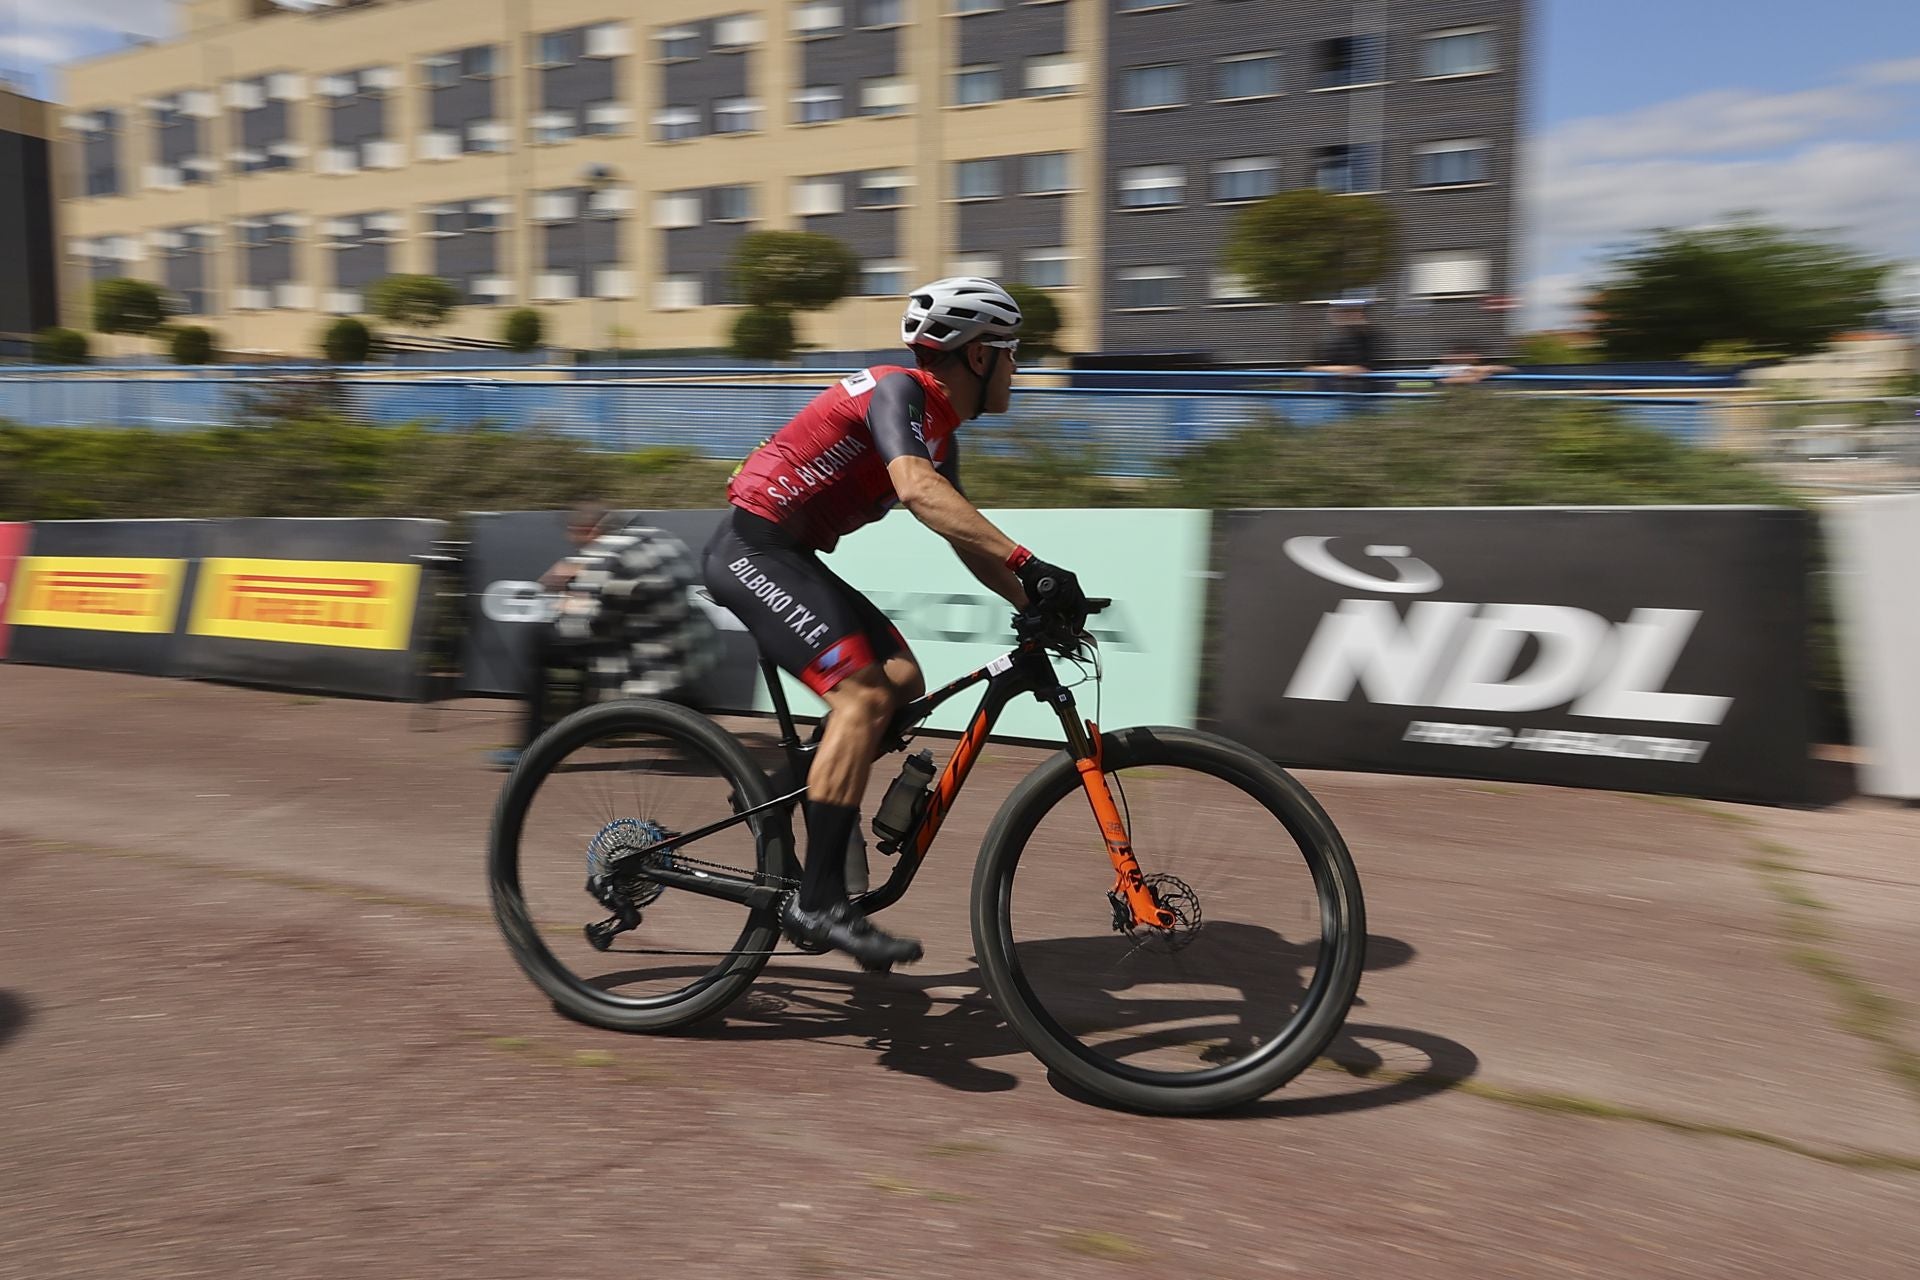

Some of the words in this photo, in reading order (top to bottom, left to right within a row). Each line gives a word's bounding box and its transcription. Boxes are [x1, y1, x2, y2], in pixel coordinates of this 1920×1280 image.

[767, 475, 804, 506] S.C.
[728, 557, 794, 614] BILBOKO
[1283, 599, 1735, 726] NDL
